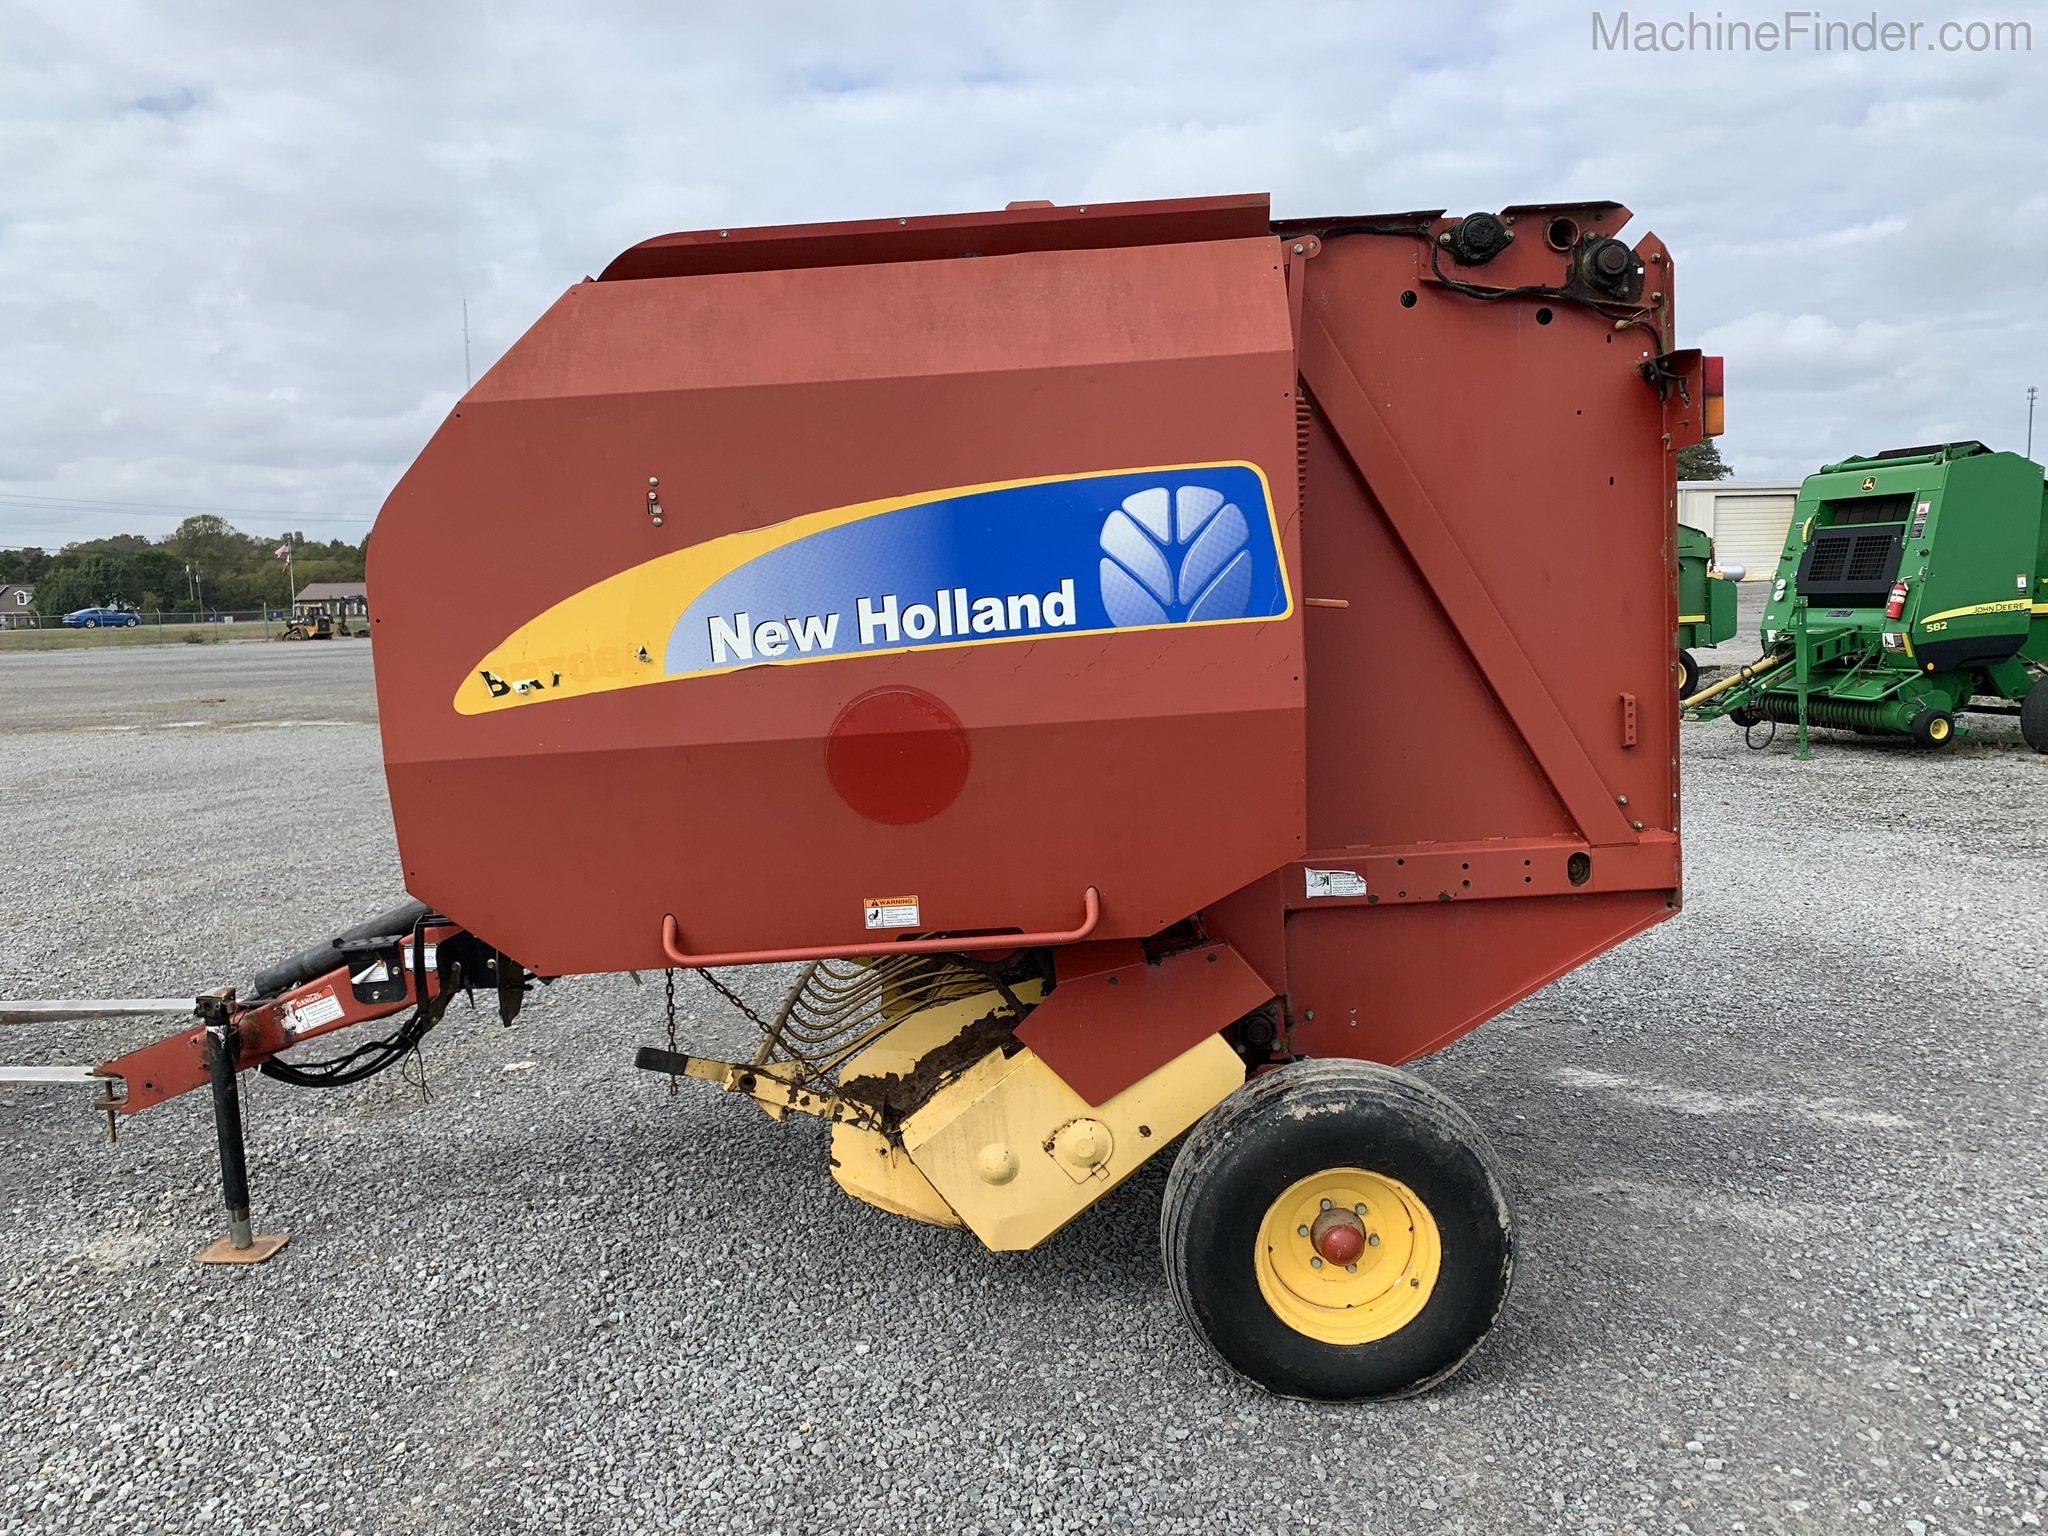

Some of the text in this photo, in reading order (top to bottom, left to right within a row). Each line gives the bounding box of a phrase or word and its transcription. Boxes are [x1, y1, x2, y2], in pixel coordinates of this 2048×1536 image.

[1973, 602, 2025, 614] JOHN DEERE
[707, 578, 1077, 664] New Holland
[1926, 621, 1948, 633] 582
[879, 898, 913, 906] WARNING
[296, 993, 323, 1008] DANGER
